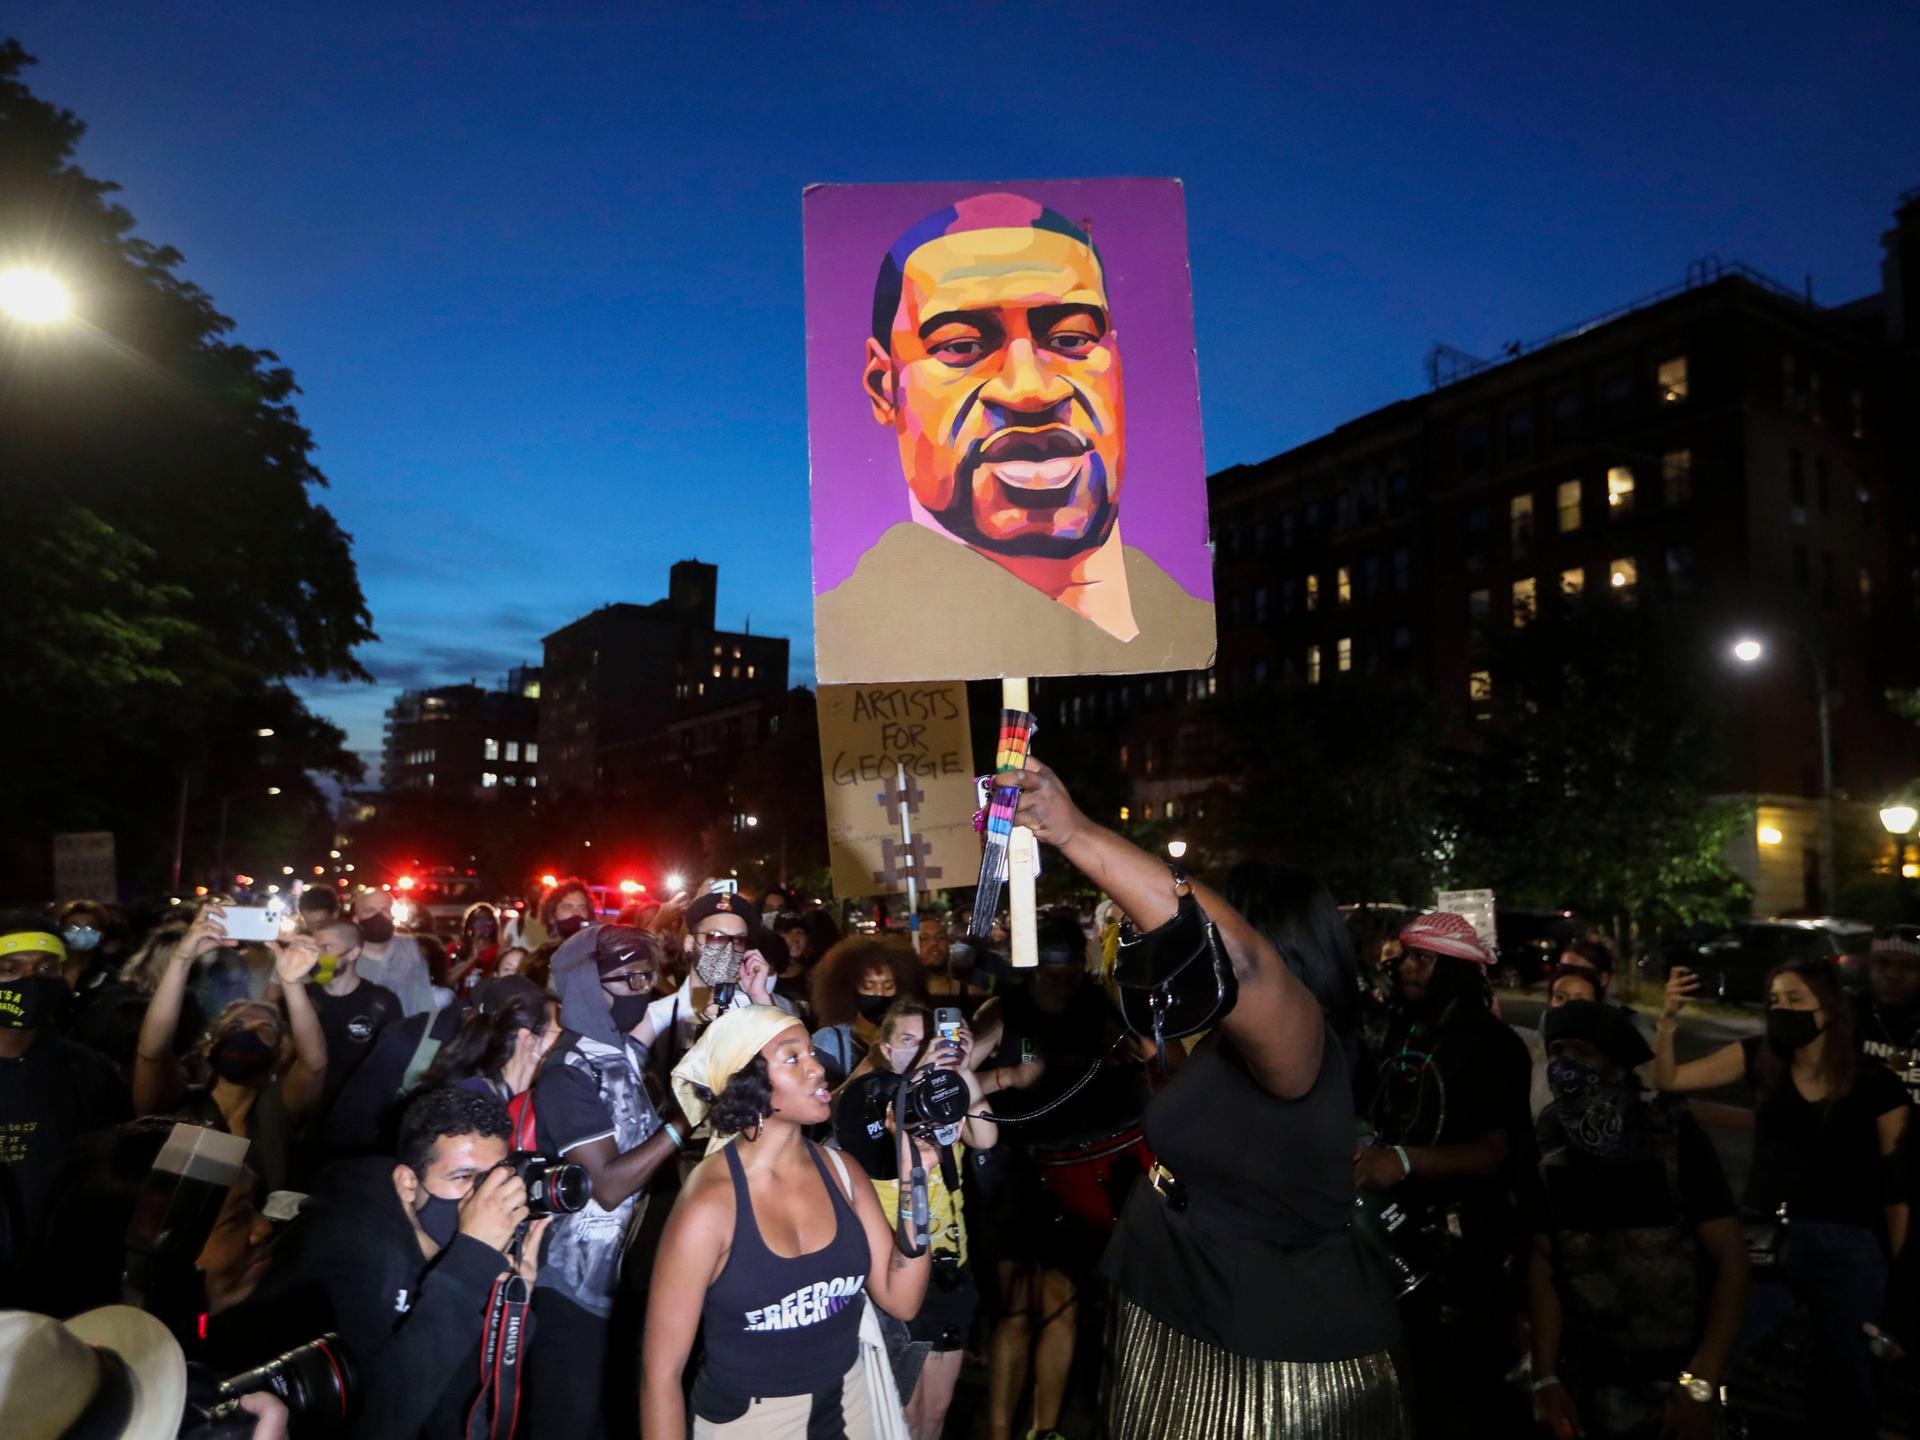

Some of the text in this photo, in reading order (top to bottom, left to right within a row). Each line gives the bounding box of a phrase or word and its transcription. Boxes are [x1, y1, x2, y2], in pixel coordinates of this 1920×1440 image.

[853, 688, 959, 722] ARTISTS
[881, 722, 929, 751] FOR
[832, 751, 964, 786] GEORGE
[503, 1316, 520, 1365] Canon
